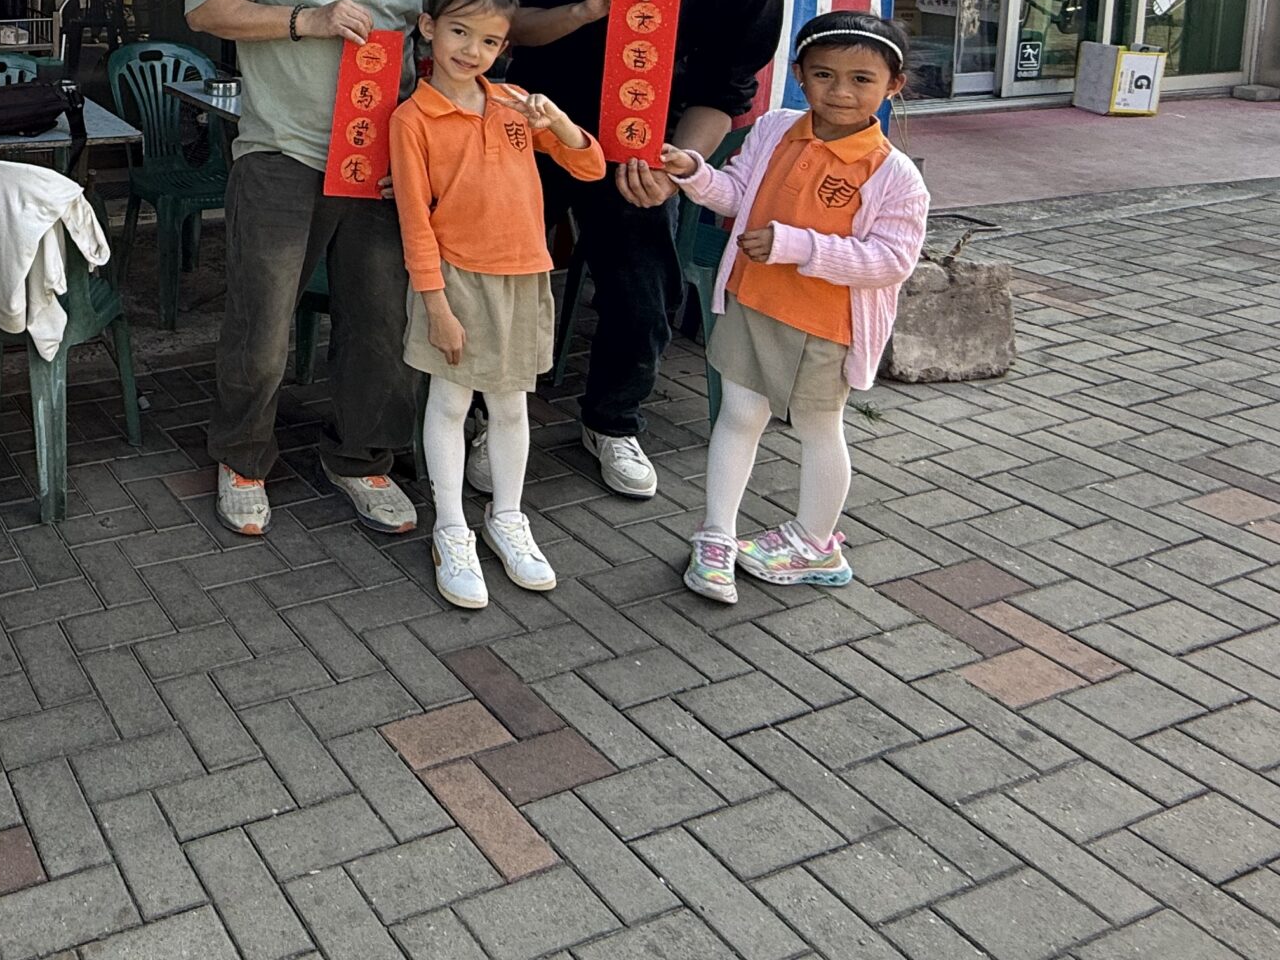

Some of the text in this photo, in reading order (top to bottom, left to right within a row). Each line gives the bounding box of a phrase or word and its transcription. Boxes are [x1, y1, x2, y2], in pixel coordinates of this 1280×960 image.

[344, 55, 381, 183] 一馬當先
[625, 11, 654, 144] 大吉大利
